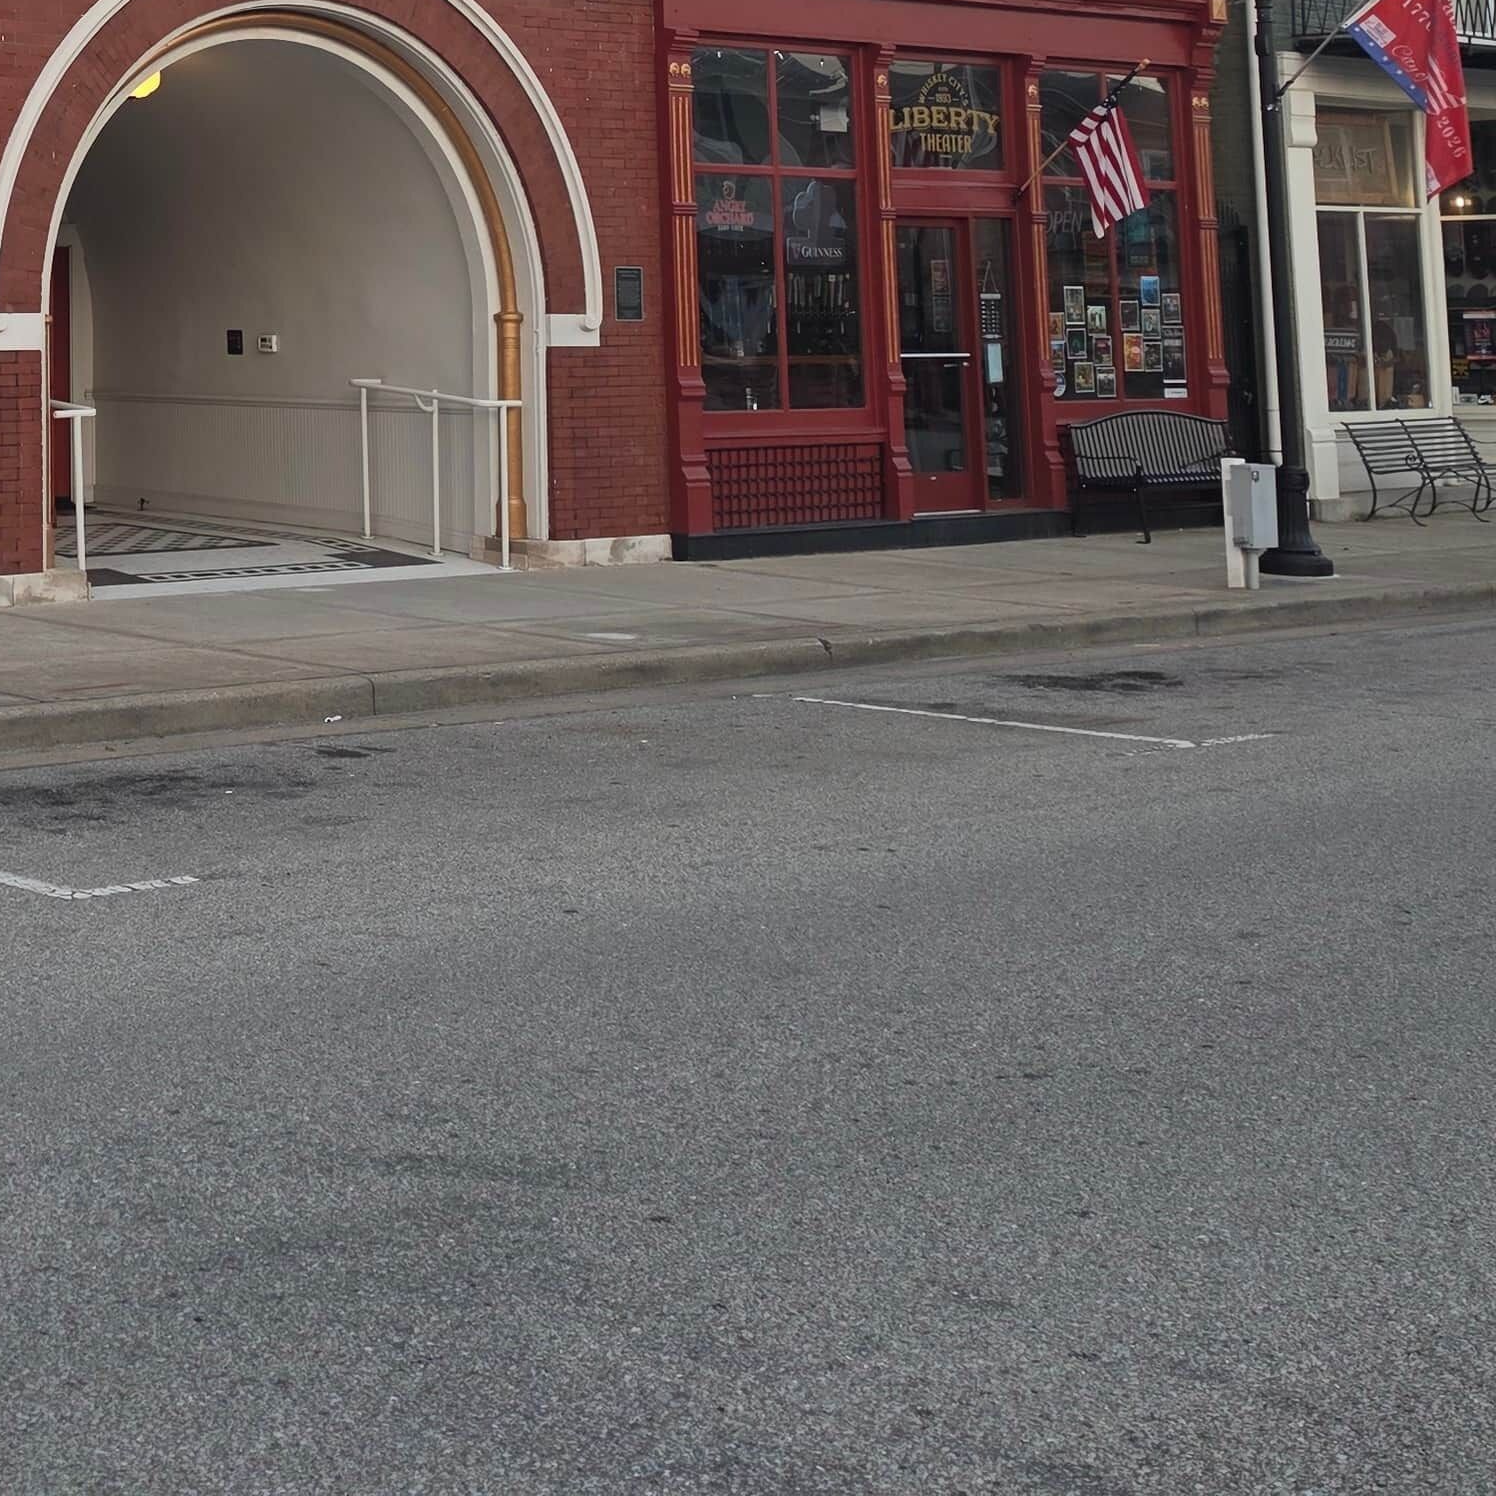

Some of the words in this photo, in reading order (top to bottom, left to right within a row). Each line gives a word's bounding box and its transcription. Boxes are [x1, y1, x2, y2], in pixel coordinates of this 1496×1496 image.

[918, 72, 947, 104] WHISKEY
[889, 106, 1000, 136] LIBERTY
[920, 133, 973, 153] THEATER
[1436, 116, 1467, 159] 2026
[706, 212, 754, 224] ORCHARD
[800, 245, 843, 258] GUINNESS
